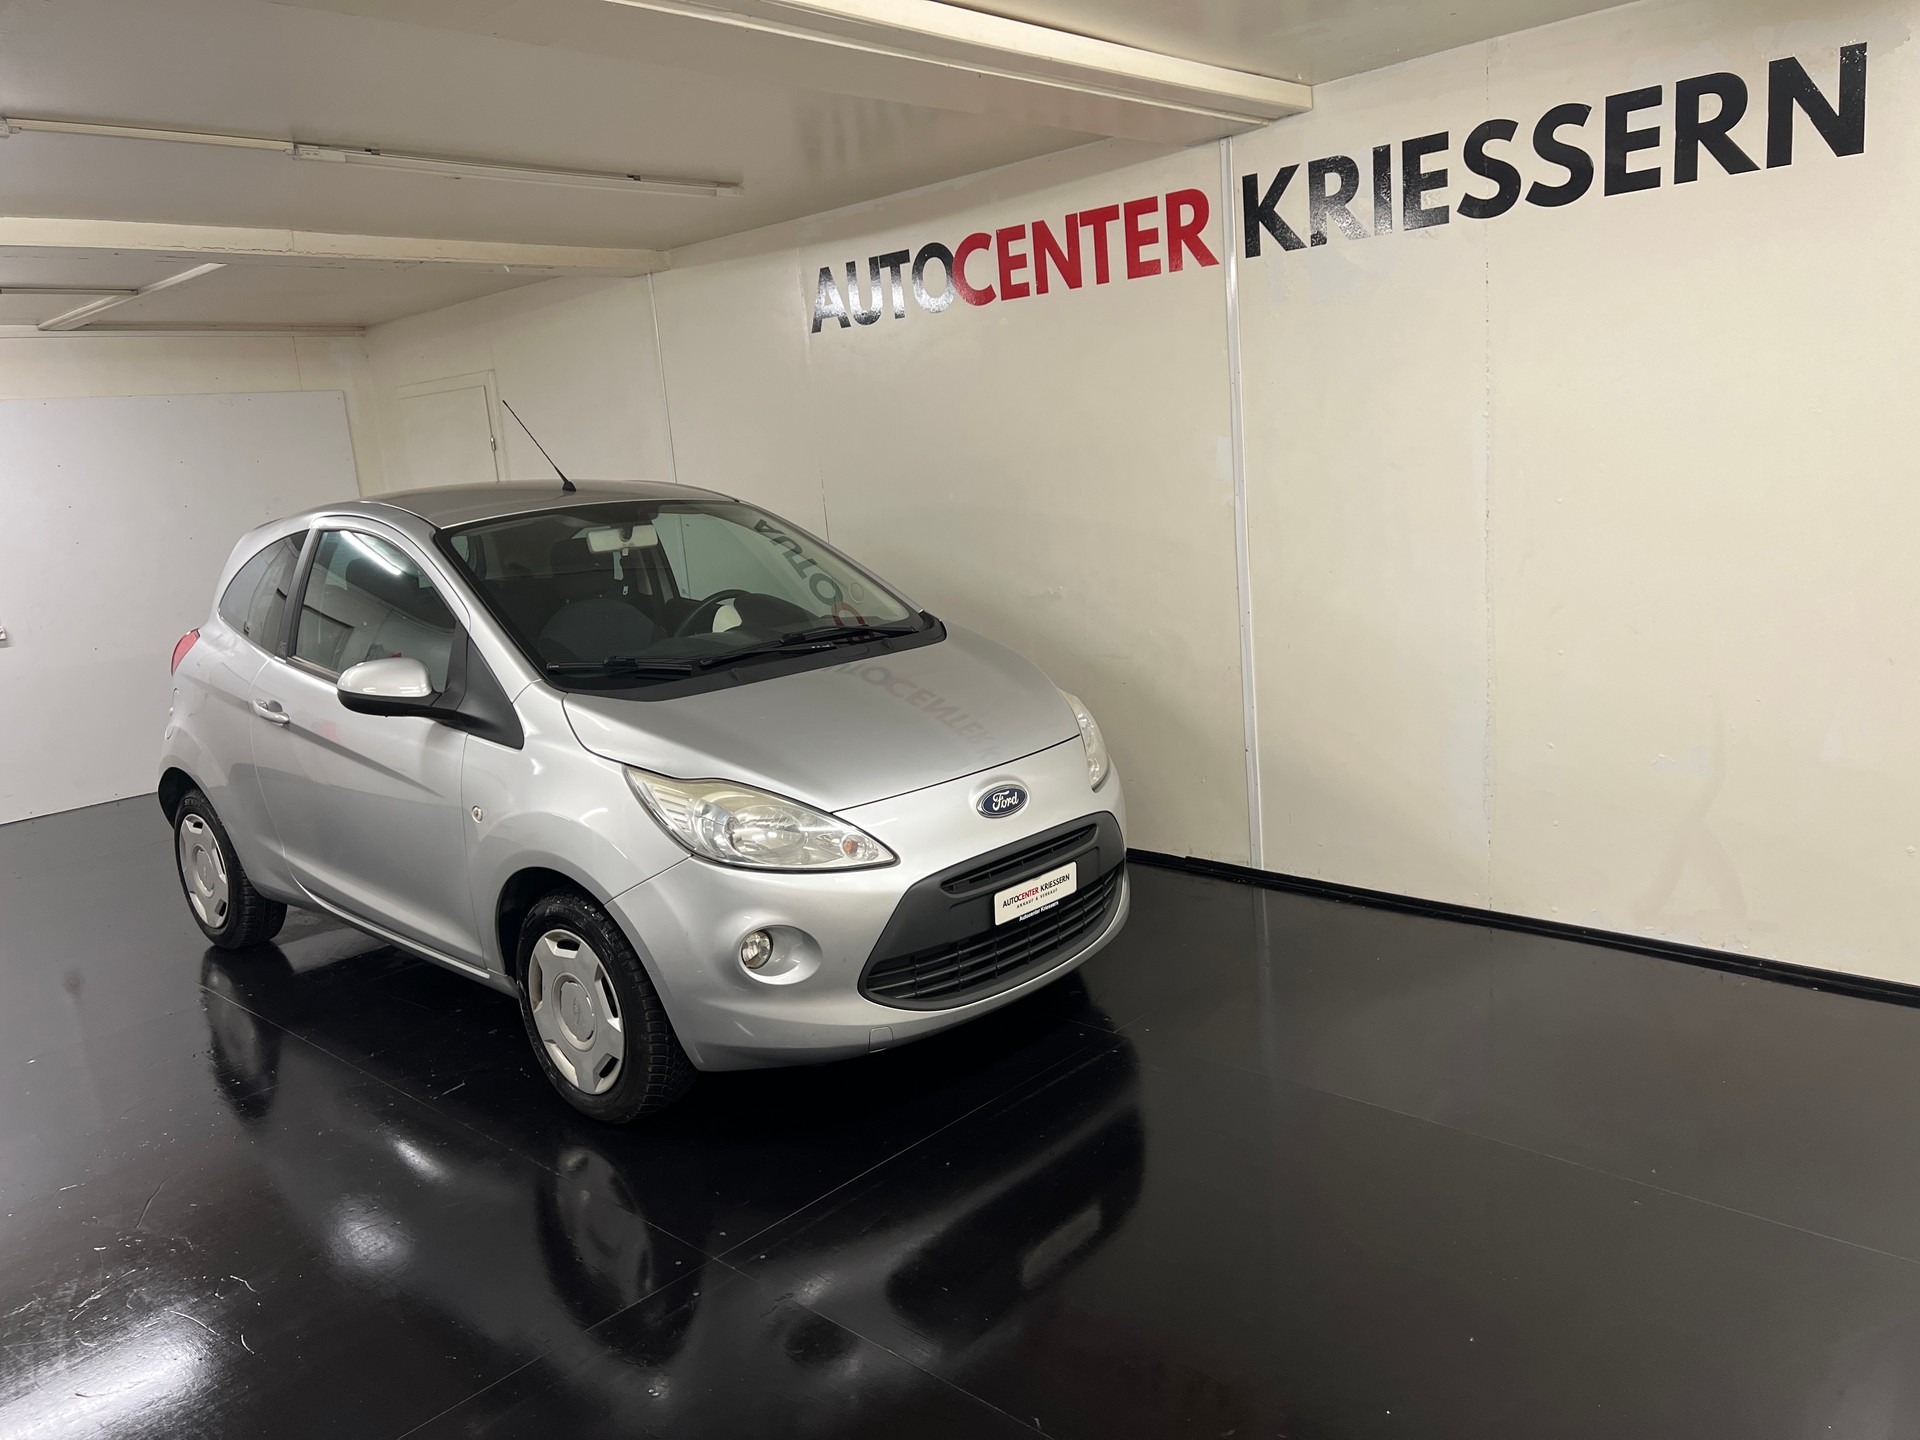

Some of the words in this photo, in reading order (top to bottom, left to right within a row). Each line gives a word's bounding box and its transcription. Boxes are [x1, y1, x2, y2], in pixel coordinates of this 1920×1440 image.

[811, 188, 1220, 333] AUTOCENTER
[1242, 41, 1868, 258] KRIESSERN
[992, 790, 1020, 811] Ford
[1002, 887, 1039, 908] AUTOCENTER
[1040, 873, 1070, 891] KRIESSERN
